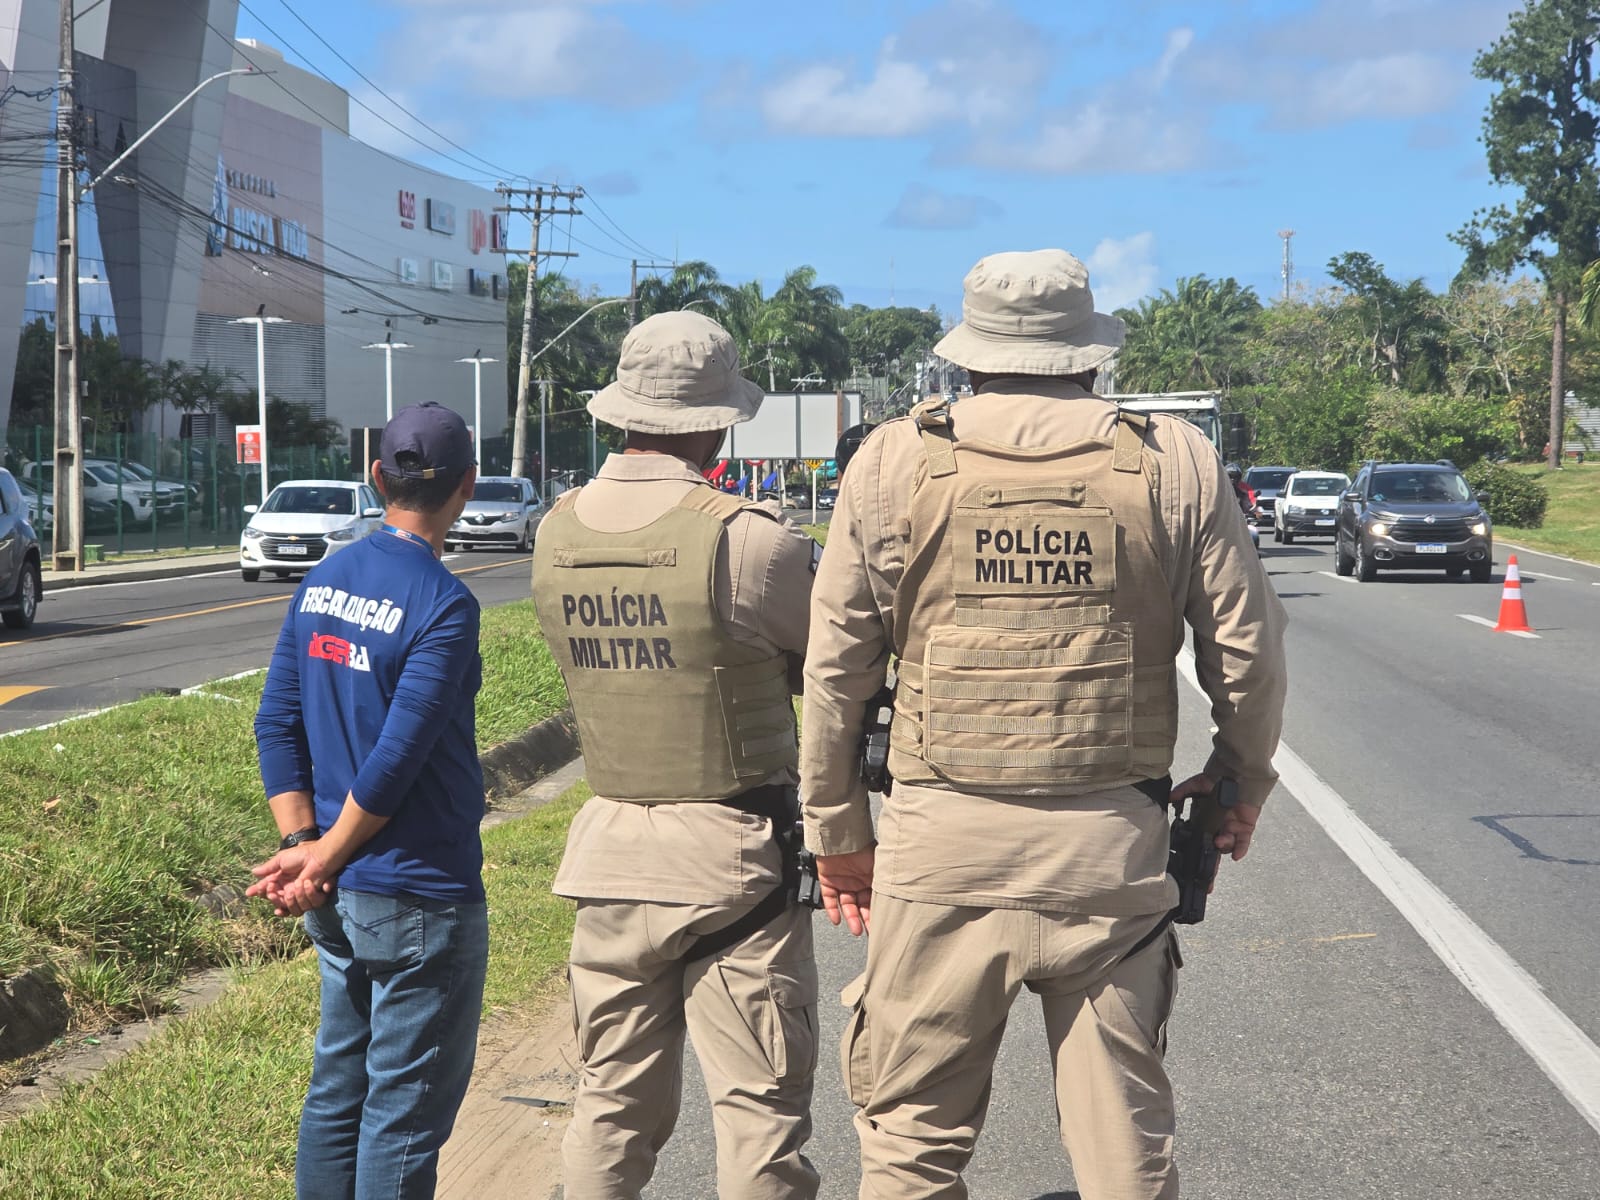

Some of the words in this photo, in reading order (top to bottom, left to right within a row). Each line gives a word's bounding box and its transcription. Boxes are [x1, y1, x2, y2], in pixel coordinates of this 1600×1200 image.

[976, 524, 1093, 555] POLÍCIA
[975, 558, 1094, 585] MILITAR
[561, 586, 668, 627] POLÍCIA
[568, 636, 677, 669] MILITAR
